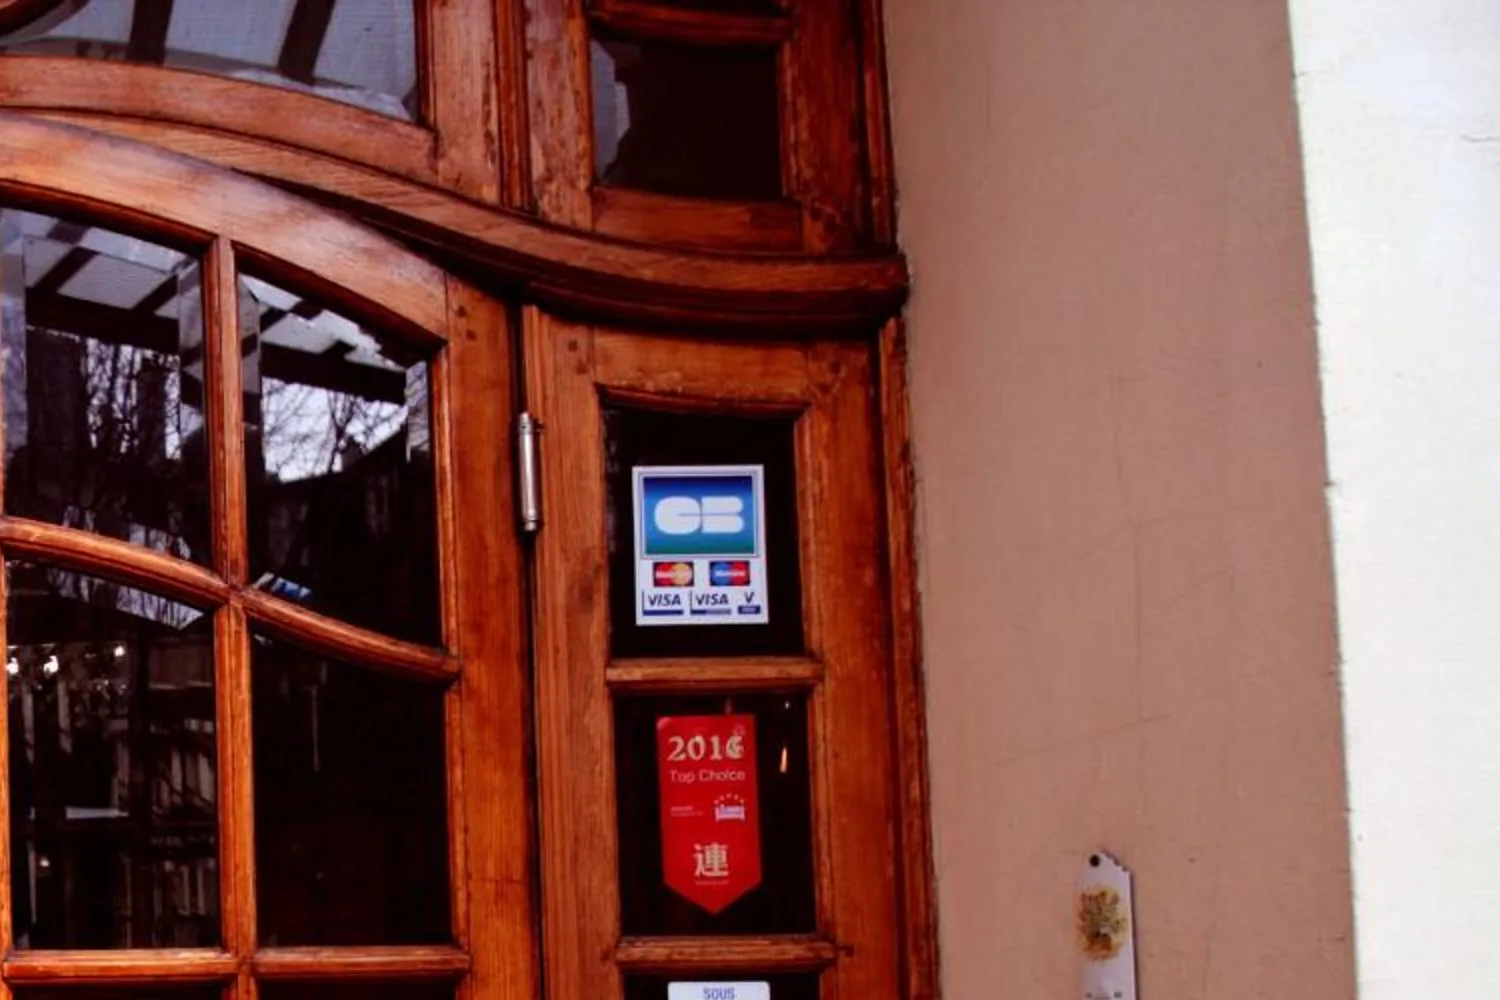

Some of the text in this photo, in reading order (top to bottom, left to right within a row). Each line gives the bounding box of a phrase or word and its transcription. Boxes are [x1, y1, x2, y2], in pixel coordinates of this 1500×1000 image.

[647, 593, 682, 607] VISA
[694, 593, 730, 607] VISA
[669, 768, 745, 784] Top Choice
[702, 986, 736, 1000] SOUS
